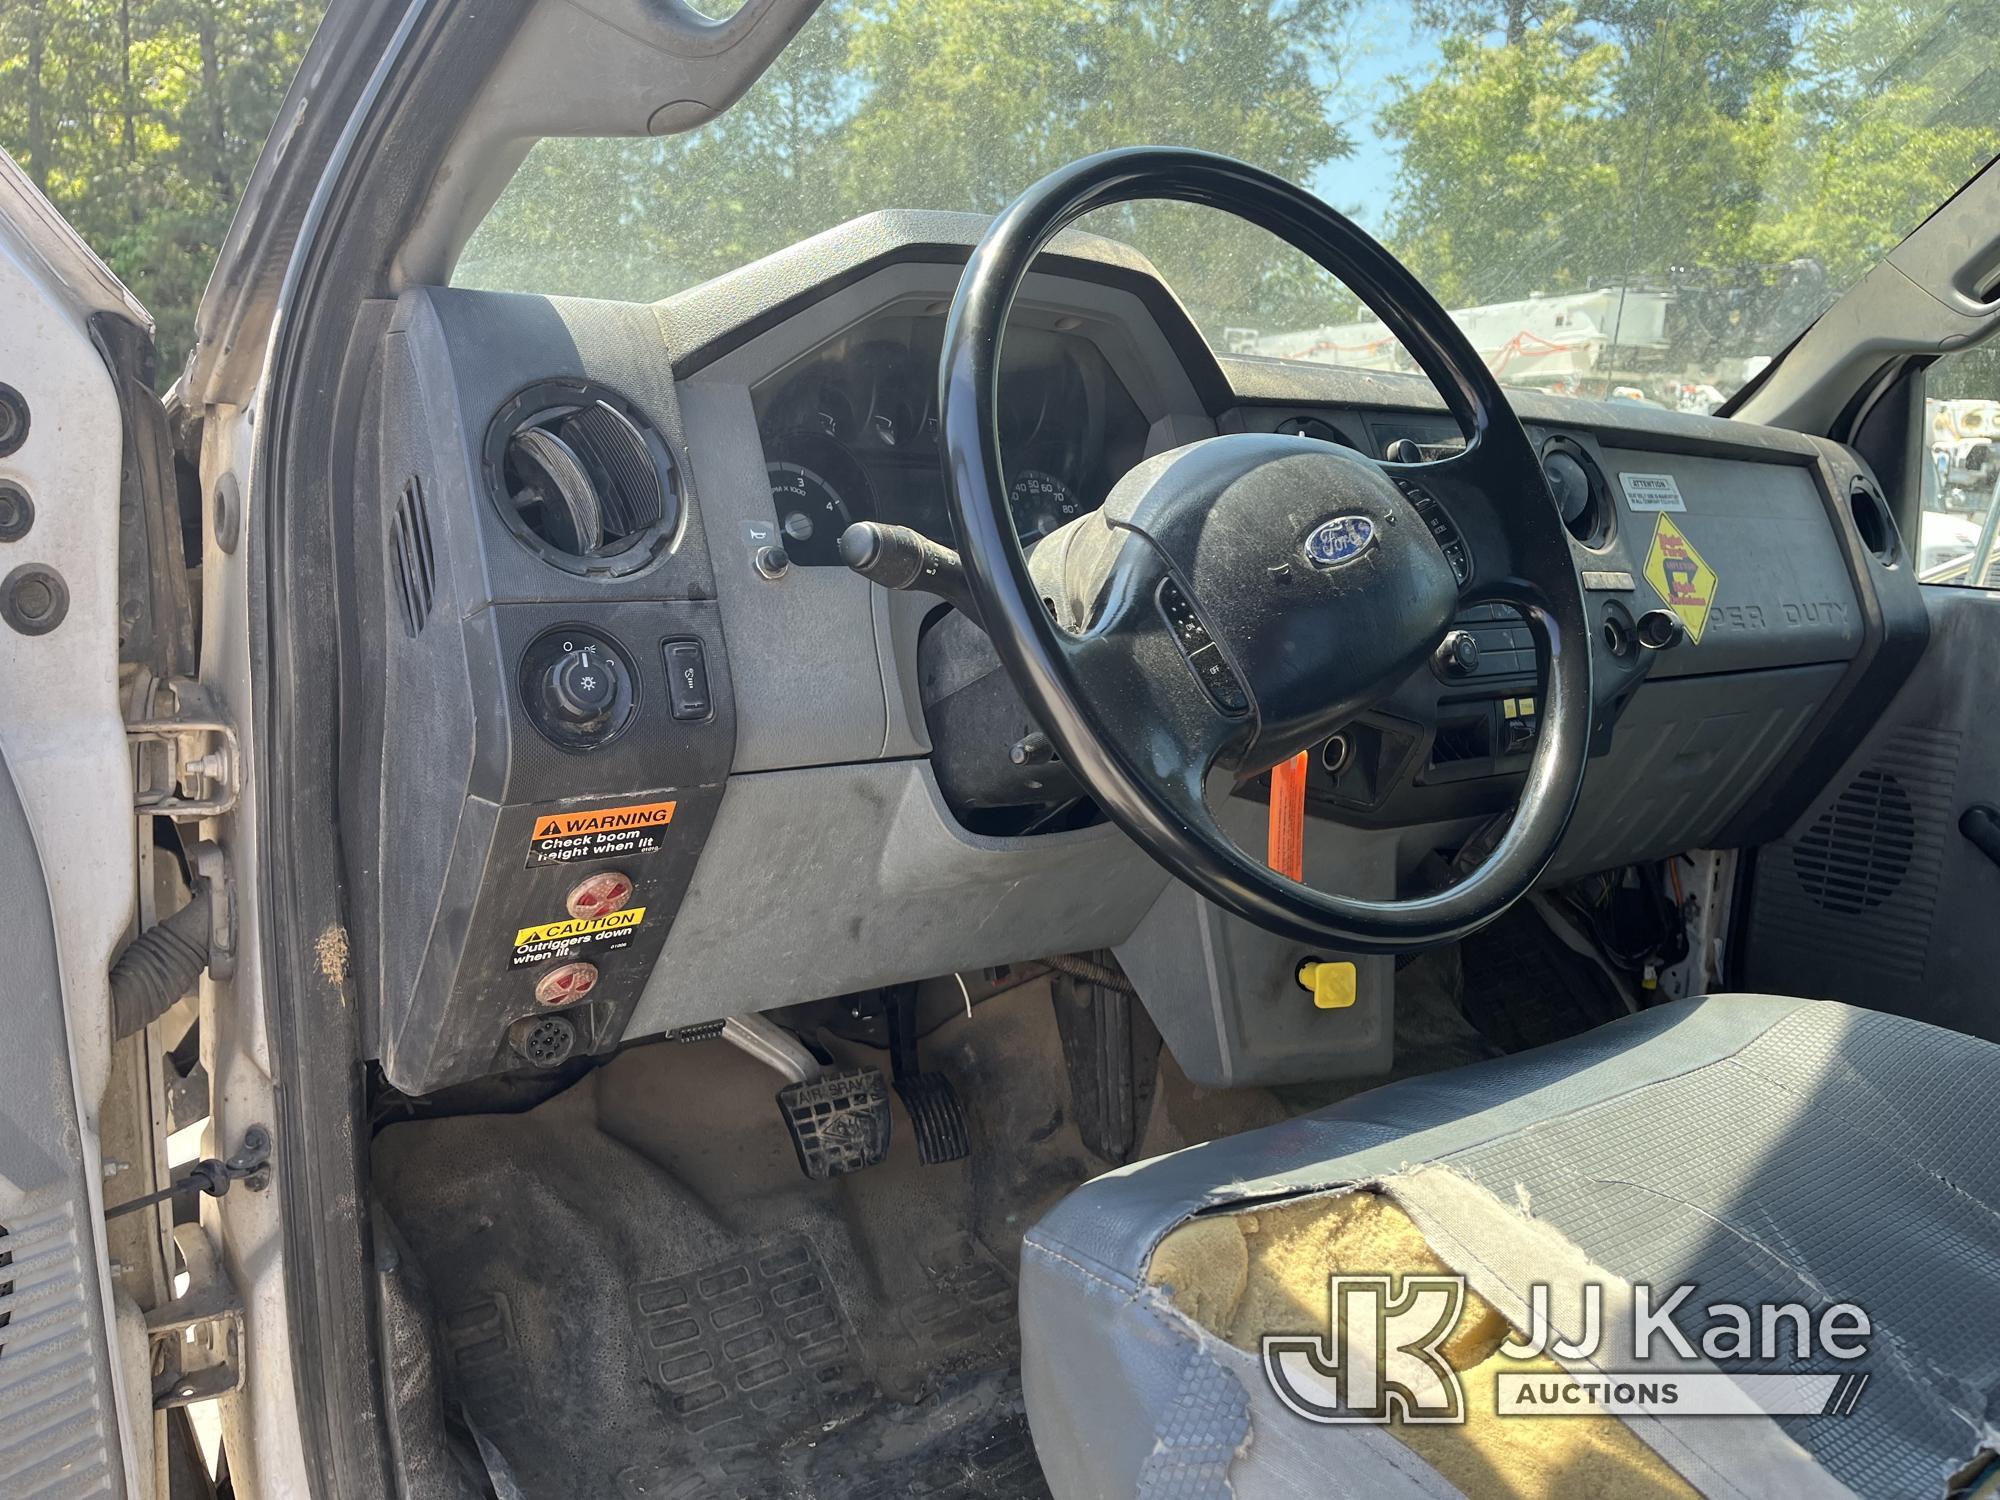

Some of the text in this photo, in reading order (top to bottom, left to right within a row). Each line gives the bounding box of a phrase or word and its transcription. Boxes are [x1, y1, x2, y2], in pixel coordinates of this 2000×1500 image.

[797, 478, 805, 488] 3
[826, 502, 834, 511] 4
[1320, 520, 1363, 556] Ford
[1710, 602, 1849, 632] PER DUTY
[566, 810, 668, 832] WARNING
[541, 830, 641, 850] Check boom
[593, 841, 634, 854] when
[638, 838, 654, 848] lit
[546, 913, 635, 937] CAUTION
[516, 927, 633, 954] Outriggers down
[513, 950, 552, 965] when
